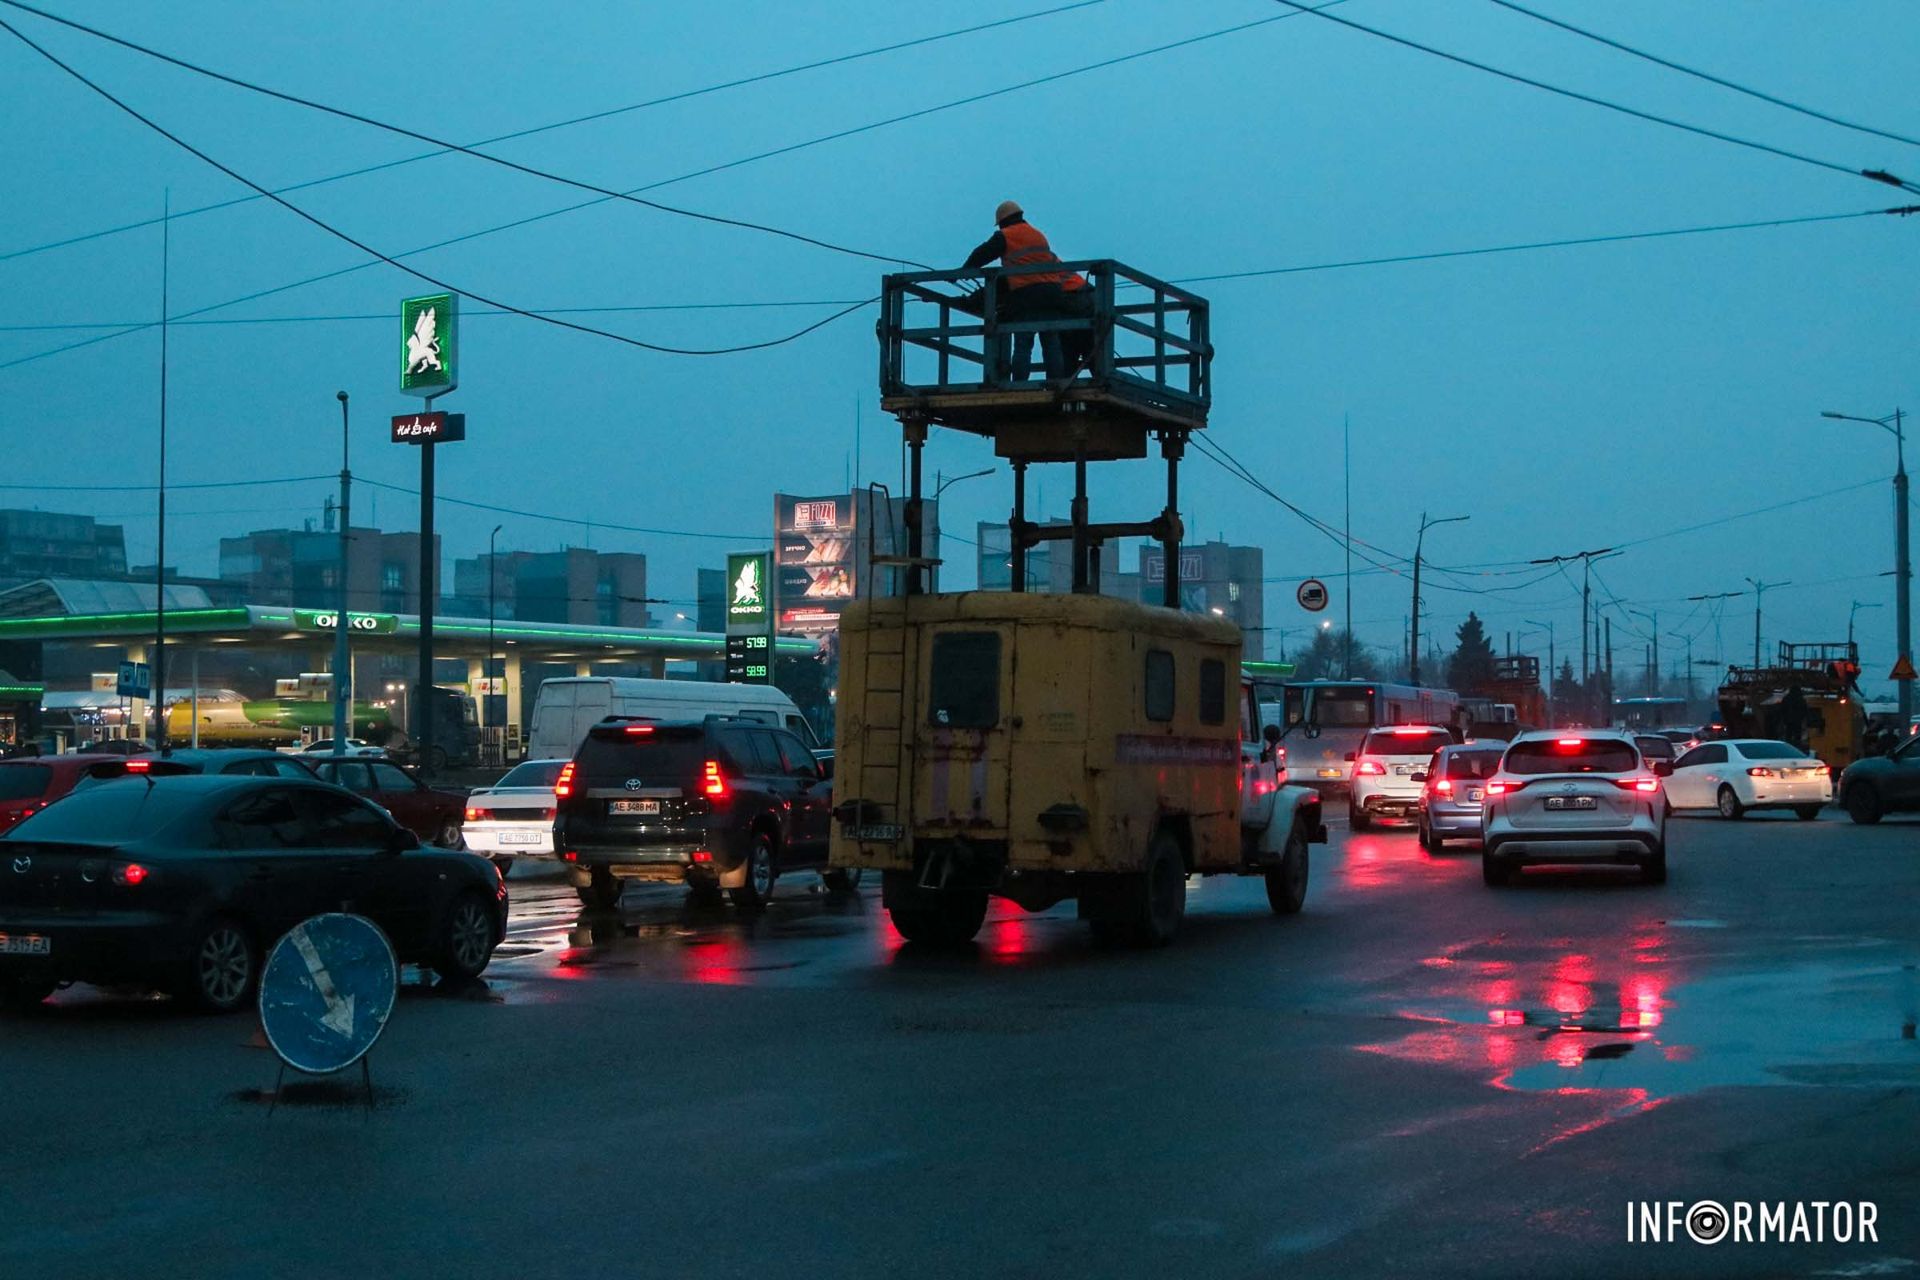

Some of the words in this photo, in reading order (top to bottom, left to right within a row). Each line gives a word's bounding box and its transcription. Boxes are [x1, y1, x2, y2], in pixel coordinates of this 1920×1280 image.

[397, 424, 411, 436] Hot
[811, 503, 834, 521] FOZZY
[615, 802, 626, 811] AE
[645, 802, 657, 811] MA
